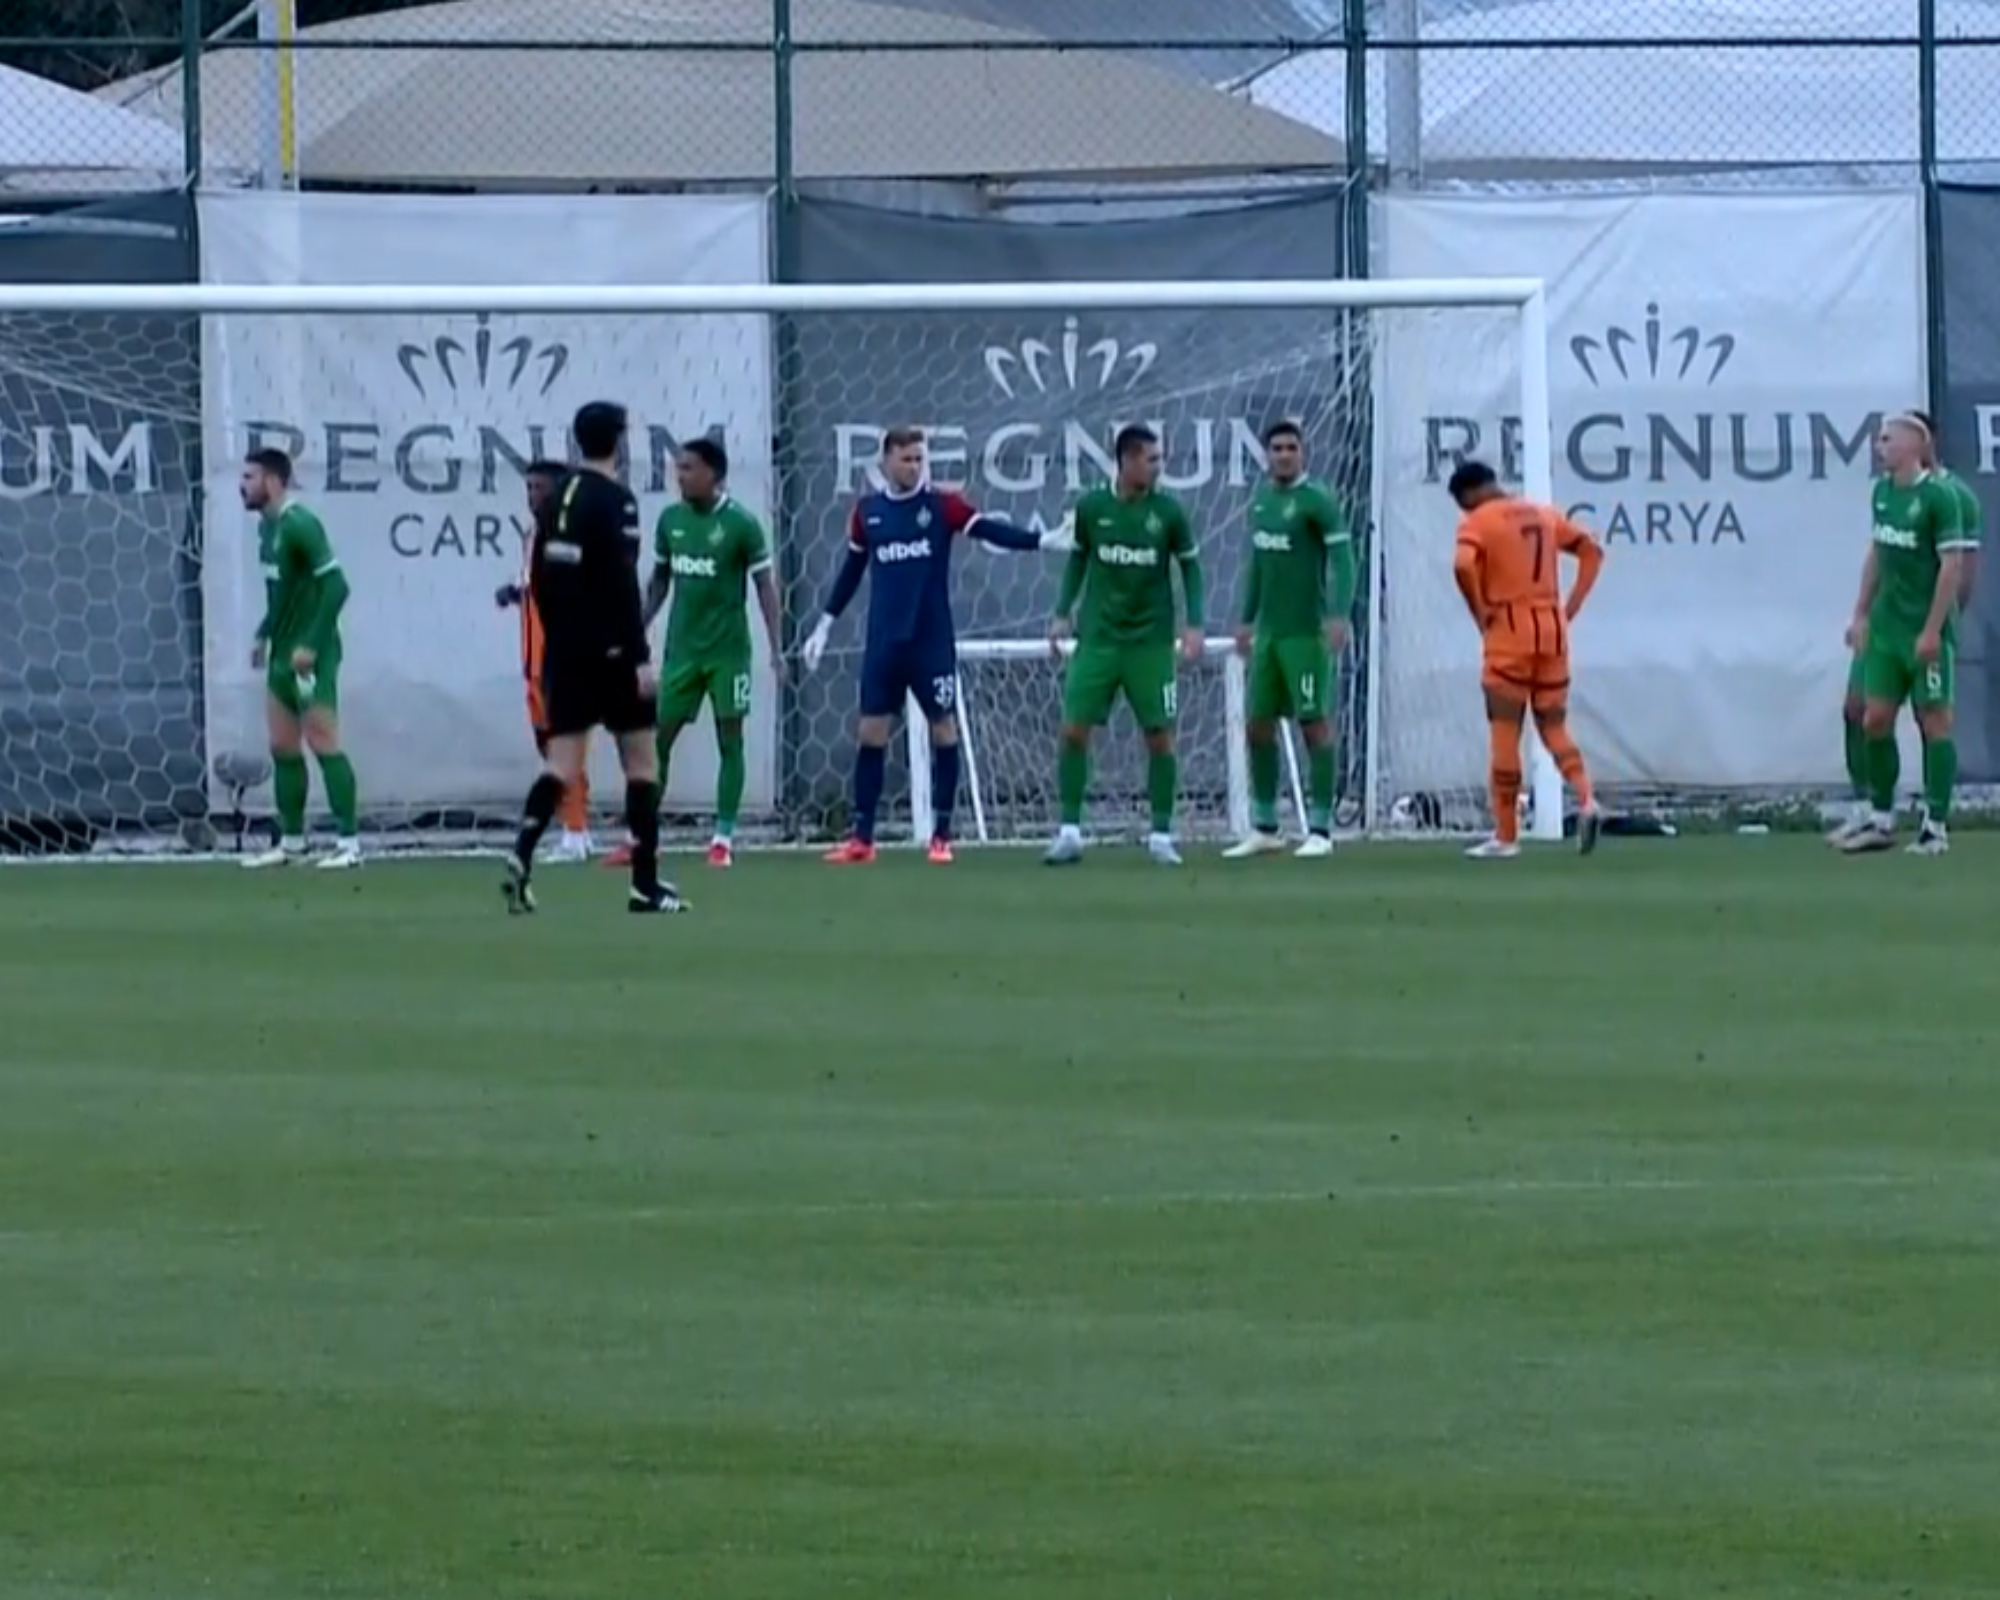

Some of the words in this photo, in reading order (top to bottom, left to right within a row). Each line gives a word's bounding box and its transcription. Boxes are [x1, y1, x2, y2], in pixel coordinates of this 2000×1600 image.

[876, 538, 931, 563] efbet
[1098, 544, 1157, 566] efbet
[1520, 524, 1543, 583] 7
[1302, 674, 1314, 702] 4
[1926, 661, 1941, 690] 6
